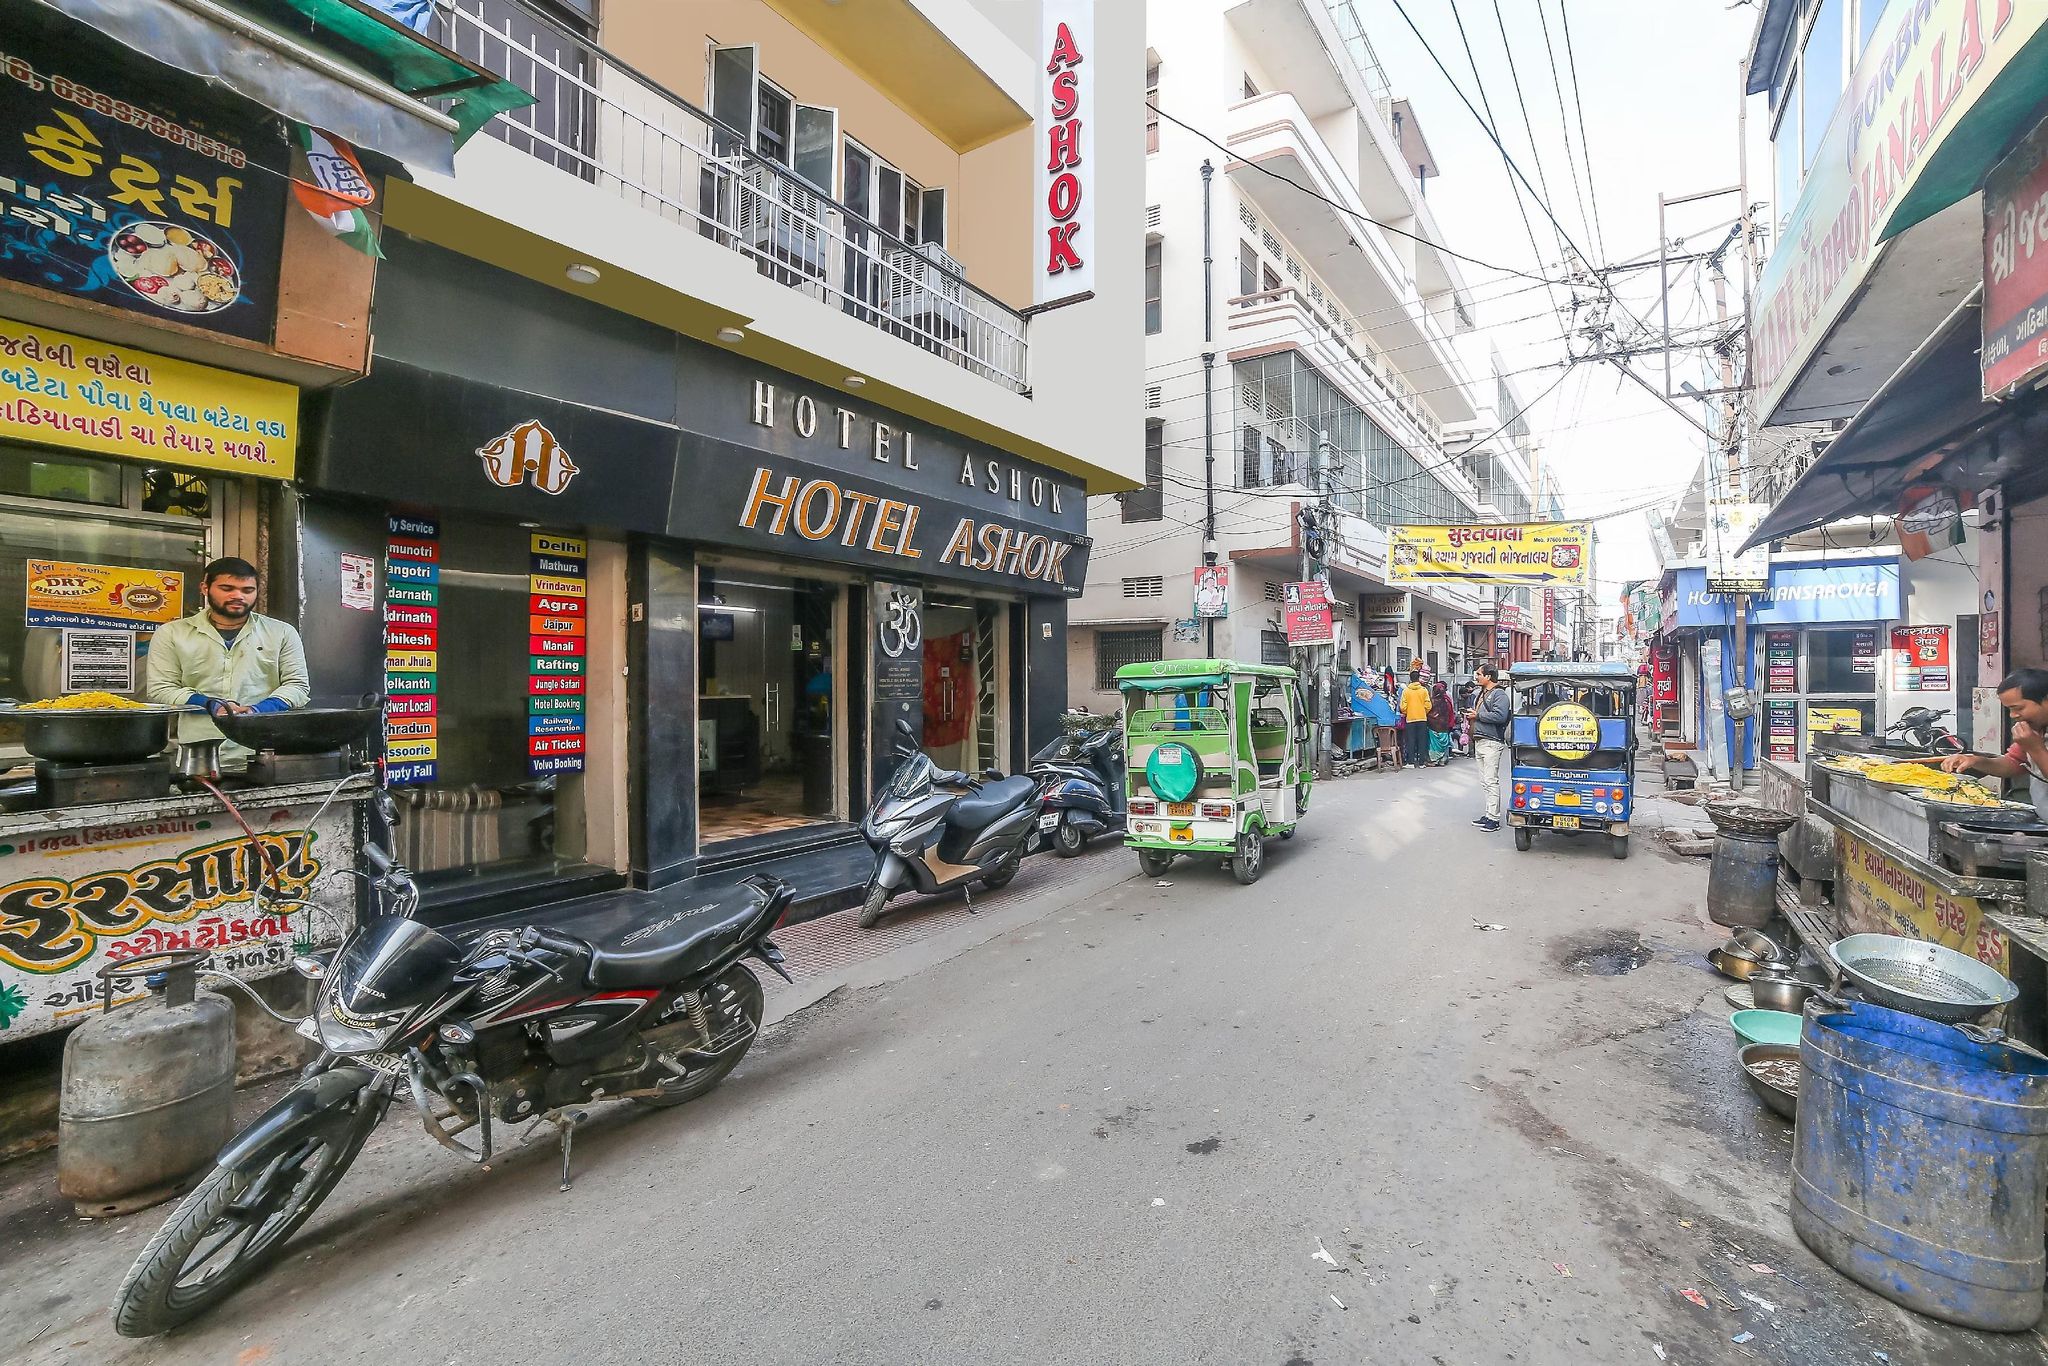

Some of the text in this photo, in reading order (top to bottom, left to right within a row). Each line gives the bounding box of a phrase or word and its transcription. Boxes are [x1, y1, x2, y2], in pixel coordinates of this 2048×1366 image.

[1046, 22, 1083, 276] ASHOK
[1, 366, 68, 398] બટેટા
[79, 380, 131, 411] પૌવા
[203, 406, 250, 433] બટેટા
[256, 420, 286, 438] વડા
[0, 398, 123, 440] ાઠિયાવાડી
[131, 426, 156, 445] ચા
[754, 380, 1063, 514] HOTEL ASHOK
[400, 519, 434, 534] Service
[738, 467, 1073, 584] HOTEL ASHOK
[539, 538, 580, 553] Delhi
[540, 558, 579, 573] Mathura
[45, 578, 89, 587] DRY
[535, 579, 582, 593] Vrindavan
[34, 585, 102, 596] BHAKHARI
[1757, 580, 1890, 603] MANSAROVER
[538, 598, 578, 612] Agra
[387, 609, 432, 624] drinath
[543, 618, 573, 632] Jaipur
[543, 640, 574, 651] Manali
[408, 655, 432, 667] Jhula
[536, 659, 579, 672] Rafting
[535, 678, 580, 691] Jungle Safari
[409, 698, 432, 712] Local
[534, 698, 581, 710] Hotel Booking
[543, 717, 573, 725] Railway
[535, 724, 581, 733] Reservation
[534, 739, 581, 751] Air Ticket
[413, 764, 432, 777] Fall
[533, 757, 582, 770] Volvo Booking
[1550, 770, 1589, 780] Singham
[353, 980, 387, 1000] HONDA
[346, 1017, 377, 1029] HONDA
